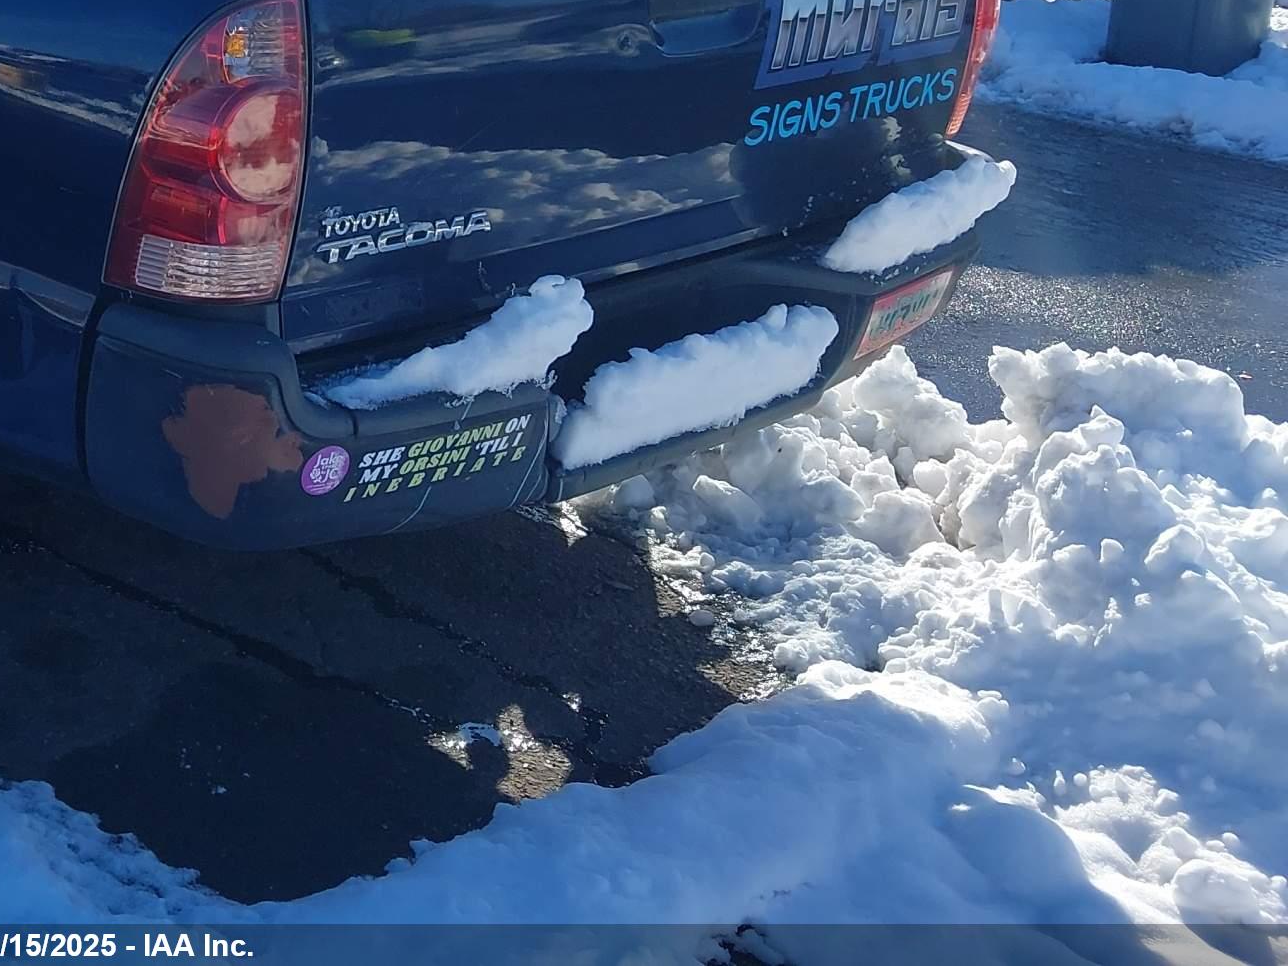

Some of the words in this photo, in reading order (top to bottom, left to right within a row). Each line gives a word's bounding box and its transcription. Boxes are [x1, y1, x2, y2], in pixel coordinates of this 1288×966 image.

[744, 91, 841, 147] SIGNS
[849, 68, 958, 123] TRUCKS
[316, 211, 492, 264] TACOMA
[321, 207, 401, 238] TOYOTA
[358, 446, 407, 469] SHE
[407, 421, 505, 459] GIOVANNI
[505, 413, 533, 435] ON
[358, 463, 399, 484] MY
[399, 445, 472, 476] ORSINI
[511, 431, 524, 447] I
[343, 445, 527, 503] INEBRIATE
